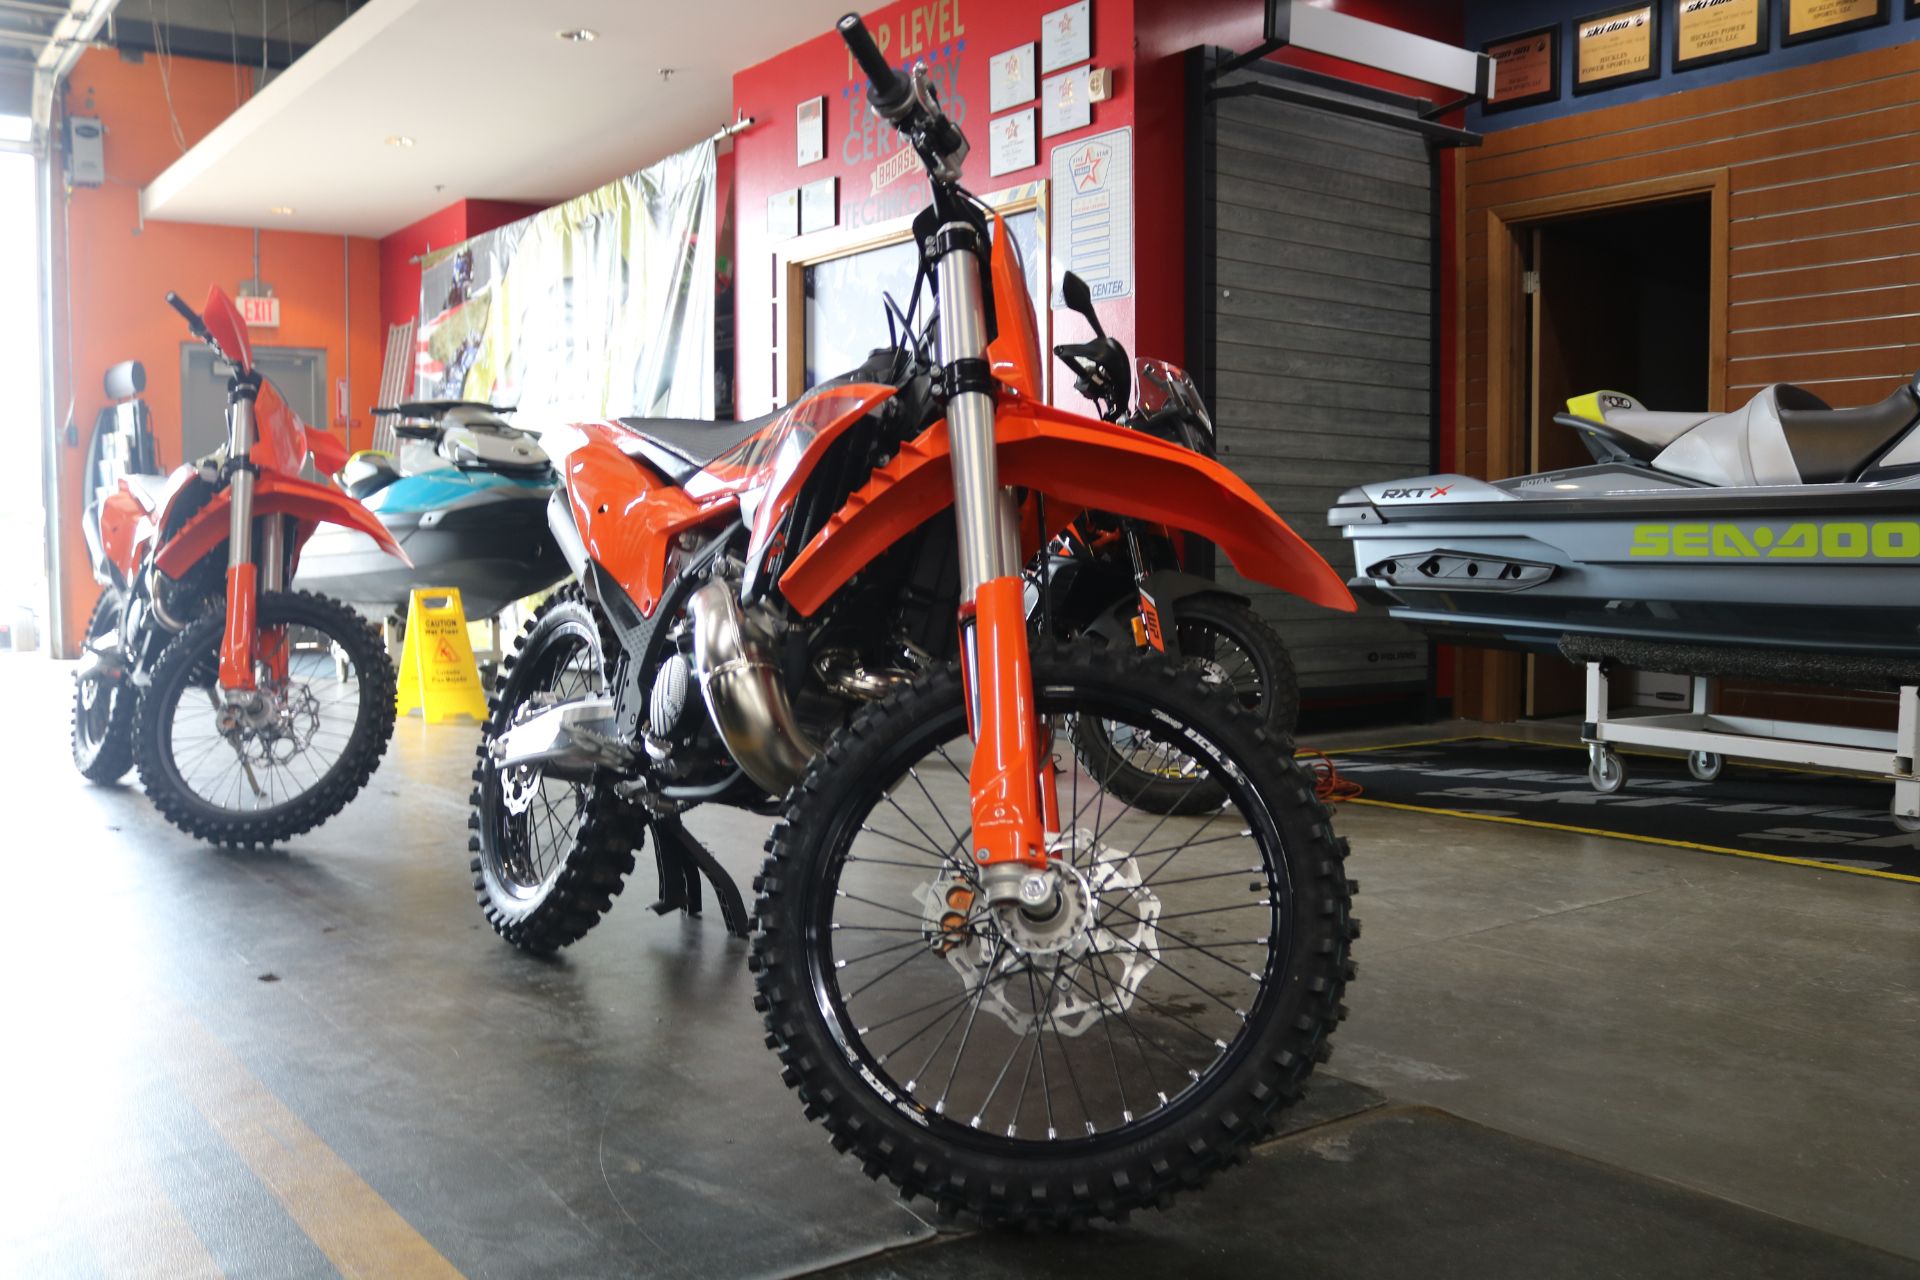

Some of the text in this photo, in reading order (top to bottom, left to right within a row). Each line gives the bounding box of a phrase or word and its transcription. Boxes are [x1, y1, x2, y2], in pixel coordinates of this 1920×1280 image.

[900, 0, 964, 59] LEVEL
[849, 56, 961, 133] FARY
[879, 147, 916, 186] BADASS
[1092, 280, 1123, 297] CENTER
[243, 299, 272, 322] EXIT
[1381, 483, 1455, 499] RXT X
[425, 619, 457, 627] CAUTION
[1184, 727, 1221, 762] EXCEL
[860, 1063, 897, 1104] EXCEL
